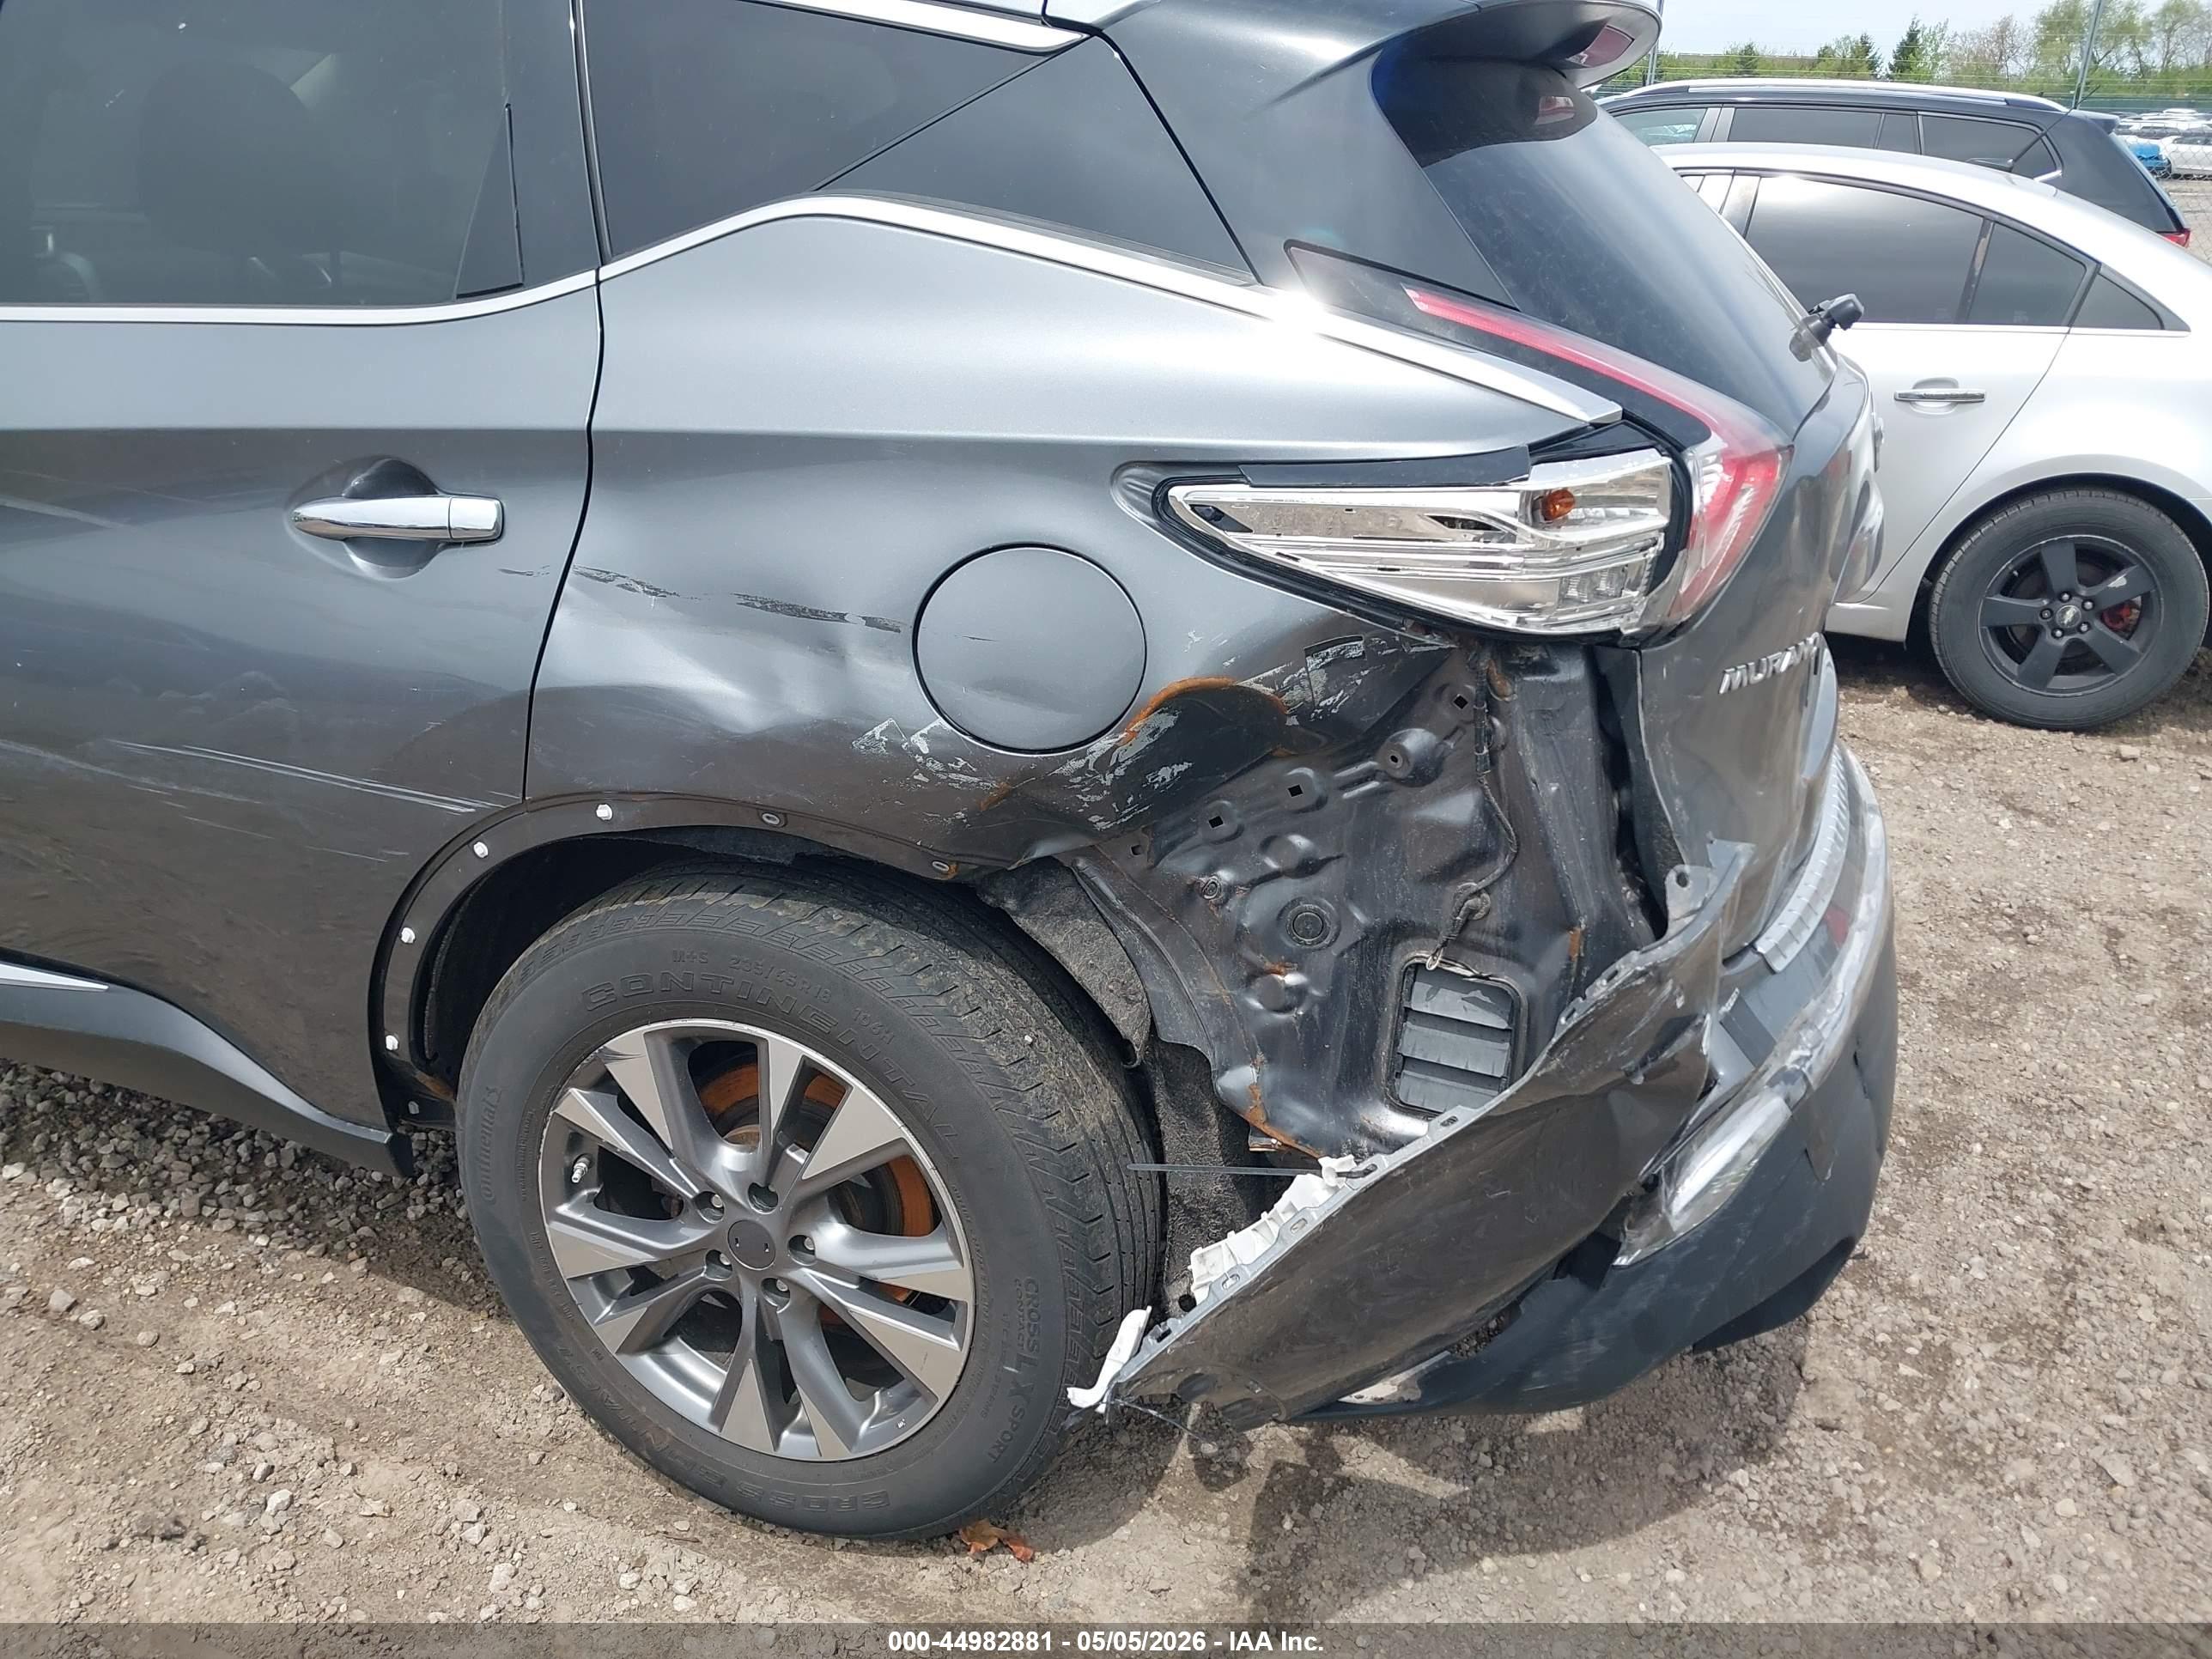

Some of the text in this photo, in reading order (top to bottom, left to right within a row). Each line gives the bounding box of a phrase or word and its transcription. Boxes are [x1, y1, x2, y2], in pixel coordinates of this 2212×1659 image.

[581, 969, 963, 1162] CONTINENTAL
[1013, 1278, 1025, 1351] CONTACT
[1023, 1277, 1042, 1354] CROSS
[985, 1404, 1028, 1464] SPORT
